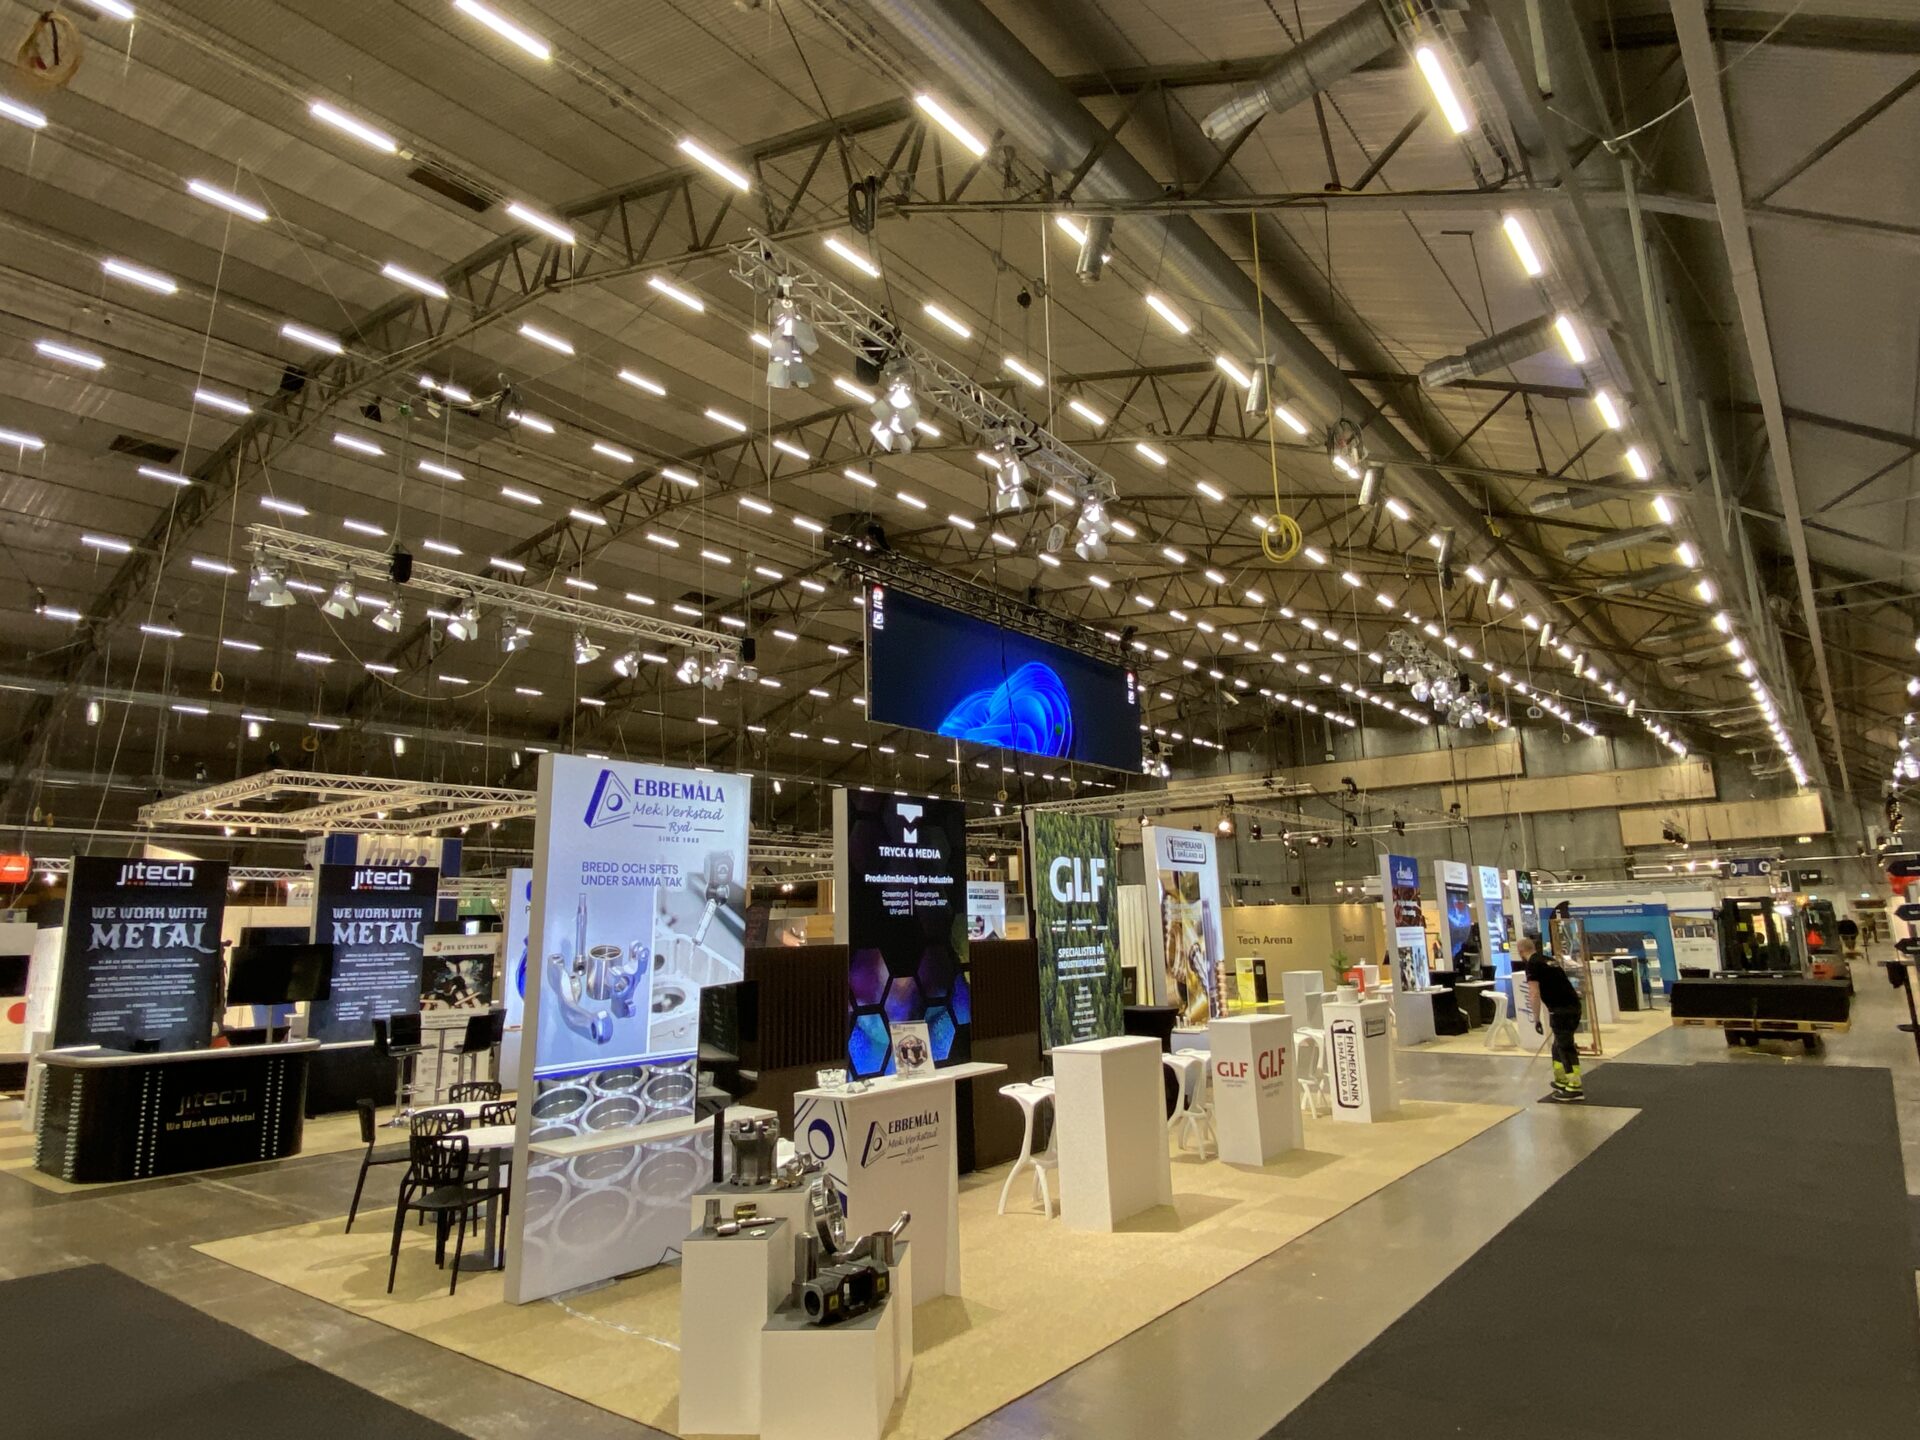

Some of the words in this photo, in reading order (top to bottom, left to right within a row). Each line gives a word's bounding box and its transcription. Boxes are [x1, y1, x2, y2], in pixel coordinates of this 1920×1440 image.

[634, 778, 726, 803] EBBEMÅLA
[633, 802, 664, 816] Mek.
[666, 804, 725, 821] Verkstad
[668, 822, 692, 834] Ryd
[878, 846, 907, 858] TRYCK
[907, 847, 914, 858] &
[915, 848, 941, 859] MEDIA
[116, 862, 195, 886] jitech
[581, 861, 619, 873] BREDD
[621, 863, 647, 874] OCH
[649, 864, 679, 875] SPETS
[351, 869, 412, 890] jitech
[581, 875, 618, 886] UNDER
[621, 876, 662, 887] SAMMA
[664, 877, 683, 887] TAK
[864, 874, 918, 885] Produktmärkning
[918, 875, 928, 883] för
[928, 875, 954, 885] industrin
[1049, 856, 1106, 903] GLF
[91, 907, 116, 919] WE
[120, 907, 165, 919] WORK
[168, 907, 208, 919] WITH
[332, 908, 353, 919] WE
[354, 908, 389, 919] WORK
[391, 908, 423, 919] WITH
[86, 922, 217, 954] METAL
[332, 921, 424, 949] METAL
[1237, 935, 1260, 945] Tech
[1263, 935, 1293, 945] Arena
[1058, 946, 1096, 958] SPECIALISTER
[1096, 943, 1105, 955] PÅ
[1216, 1061, 1249, 1078] GLF
[1258, 1046, 1286, 1080] GLF
[1337, 1041, 1347, 1088] SMÅLAND
[1342, 1090, 1349, 1102] AB
[1345, 1035, 1360, 1102] FINMEKANIK
[165, 1121, 181, 1132] We
[182, 1118, 207, 1129] Work
[209, 1115, 229, 1127] With
[231, 1112, 256, 1123] Metal
[888, 1110, 940, 1134] EBBEMÅLA
